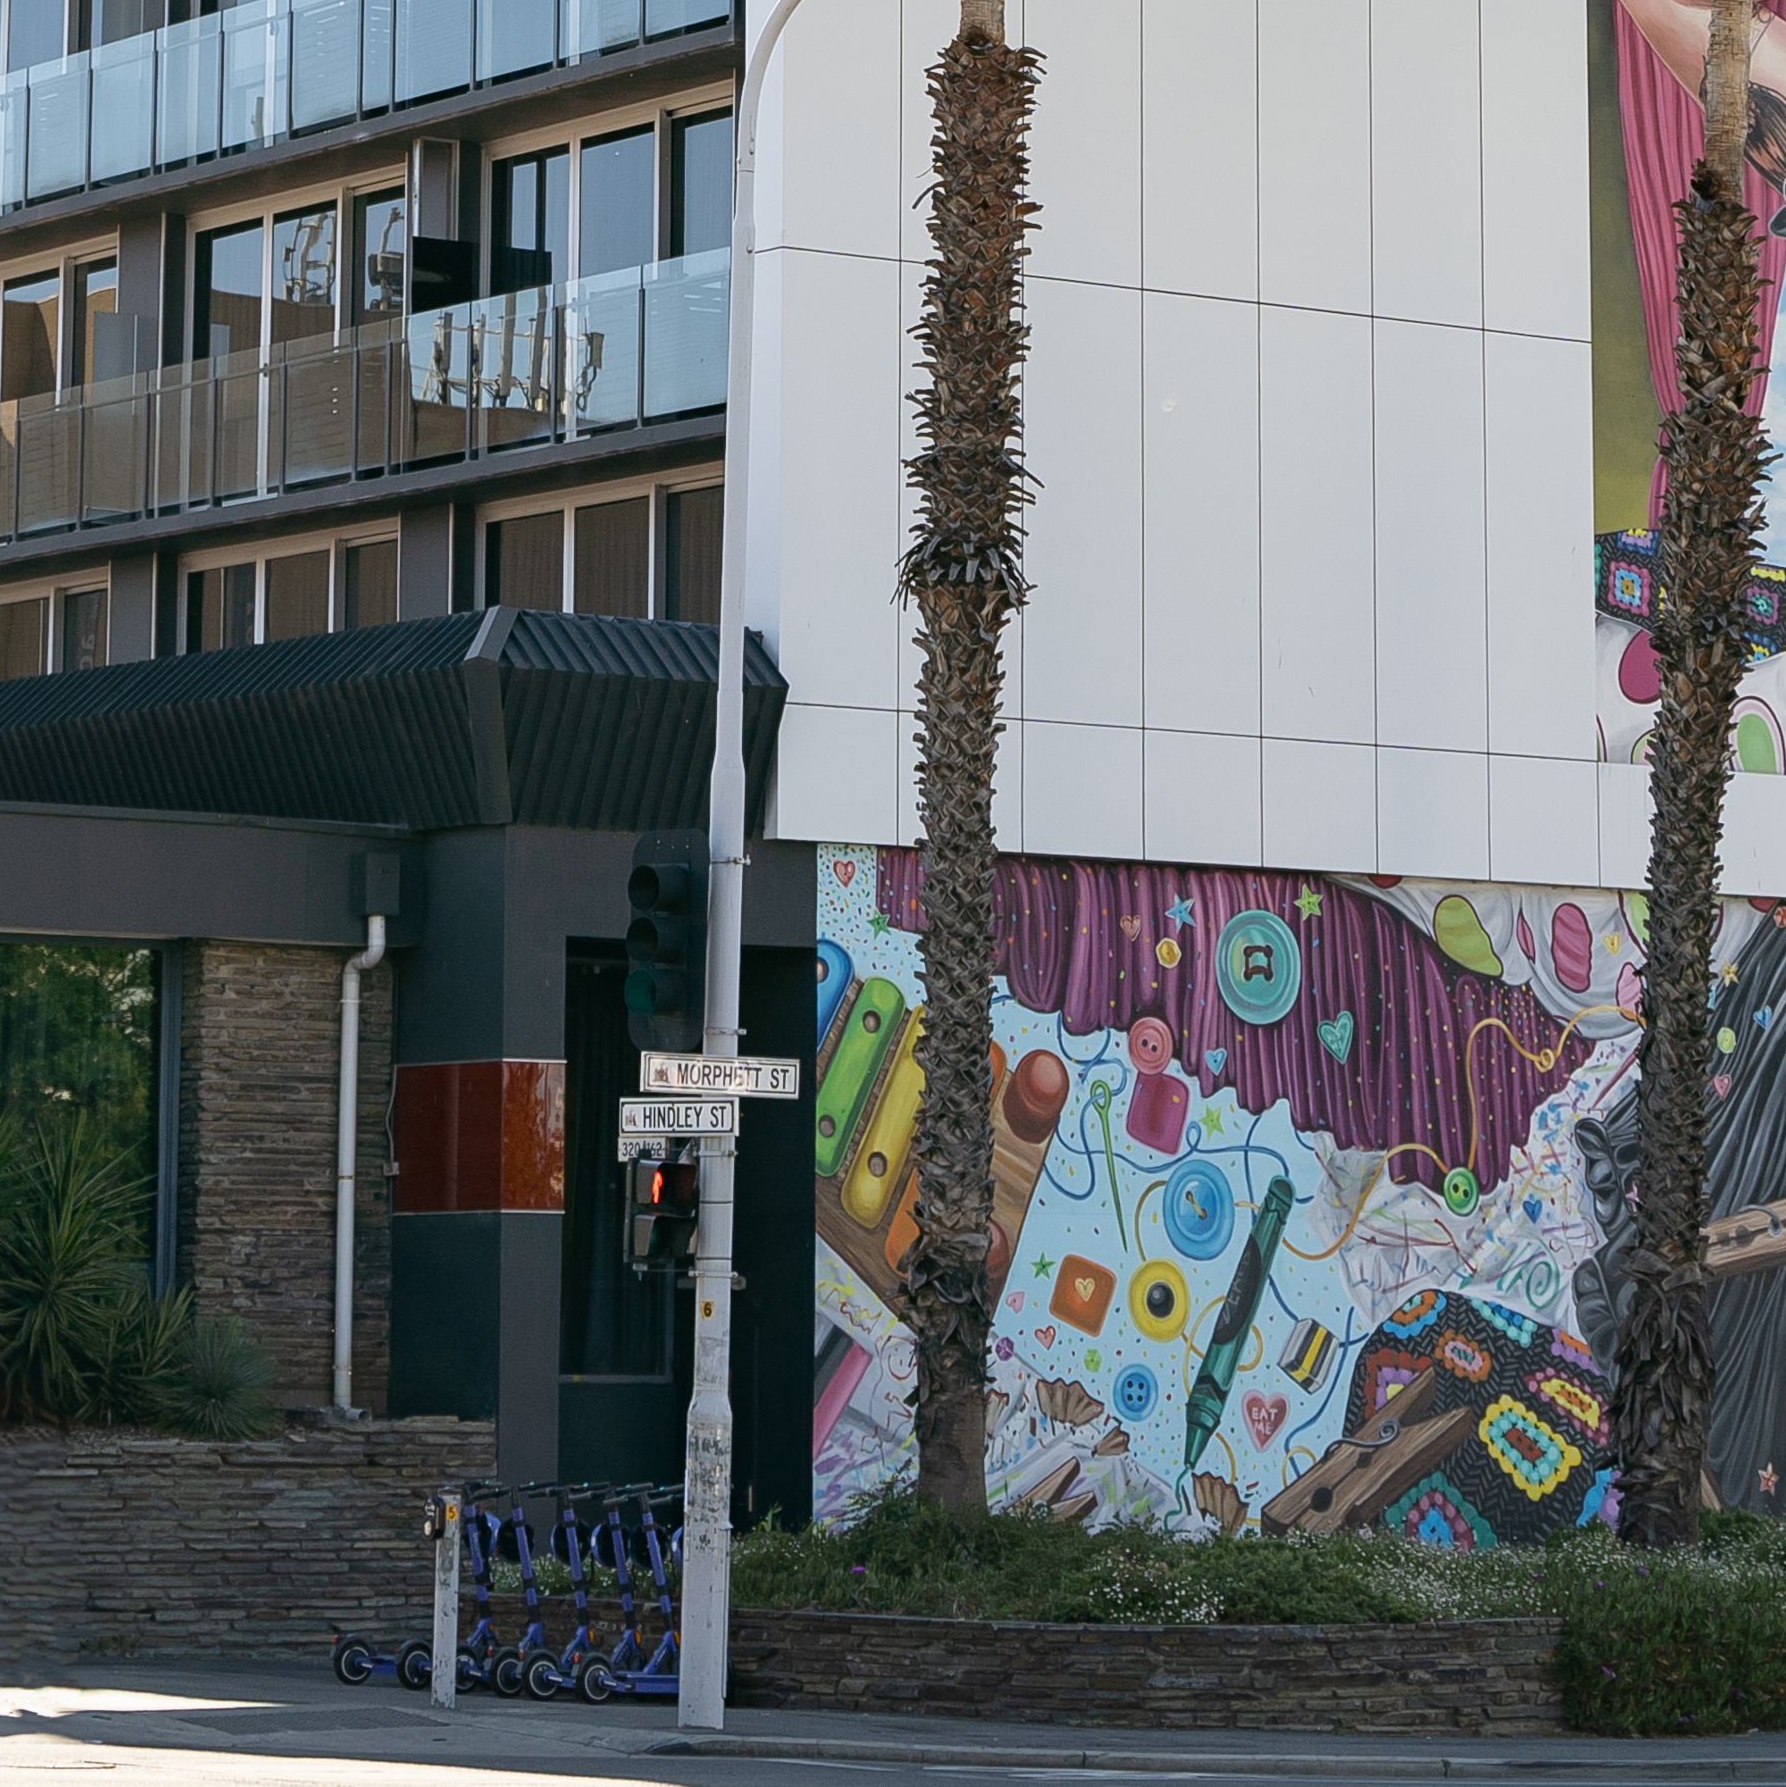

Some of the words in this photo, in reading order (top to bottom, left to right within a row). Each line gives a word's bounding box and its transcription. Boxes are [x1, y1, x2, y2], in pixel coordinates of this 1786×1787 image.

[677, 1063, 762, 1088] MORPHETT
[770, 1068, 789, 1090] ST
[643, 1106, 703, 1128] HINDLEY
[710, 1106, 727, 1128] ST
[703, 1302, 713, 1318] 6
[1252, 1407, 1279, 1422] EAT
[1254, 1421, 1275, 1435] ME
[448, 1506, 456, 1519] 5
